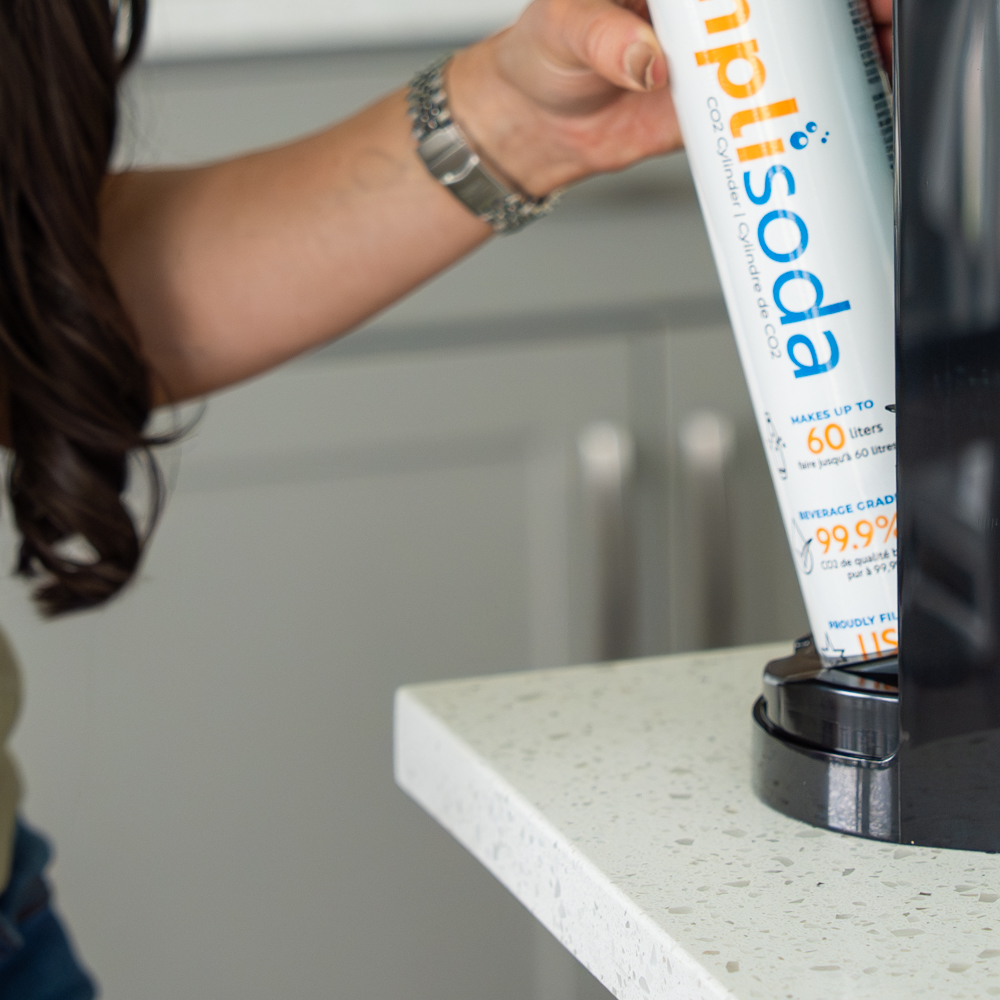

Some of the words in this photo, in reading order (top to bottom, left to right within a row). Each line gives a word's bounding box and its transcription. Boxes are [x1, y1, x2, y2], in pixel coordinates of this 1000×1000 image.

[707, 96, 724, 133] CO2
[716, 136, 742, 209] Cylinder
[738, 222, 763, 293] Cylindre
[757, 297, 770, 319] de
[764, 323, 782, 360] CO2
[791, 410, 830, 424] MAKES
[834, 405, 852, 417] UP
[855, 399, 874, 411] TO
[807, 423, 845, 455] 60
[849, 423, 884, 439] liters
[855, 447, 869, 460] 60
[799, 504, 853, 520] BEVERAGE
[857, 493, 897, 511] GRAD
[820, 559, 838, 571] CO2
[840, 559, 852, 567] de
[854, 549, 889, 566] qualité
[847, 570, 863, 581] pur
[828, 615, 875, 630] PROUDLY
